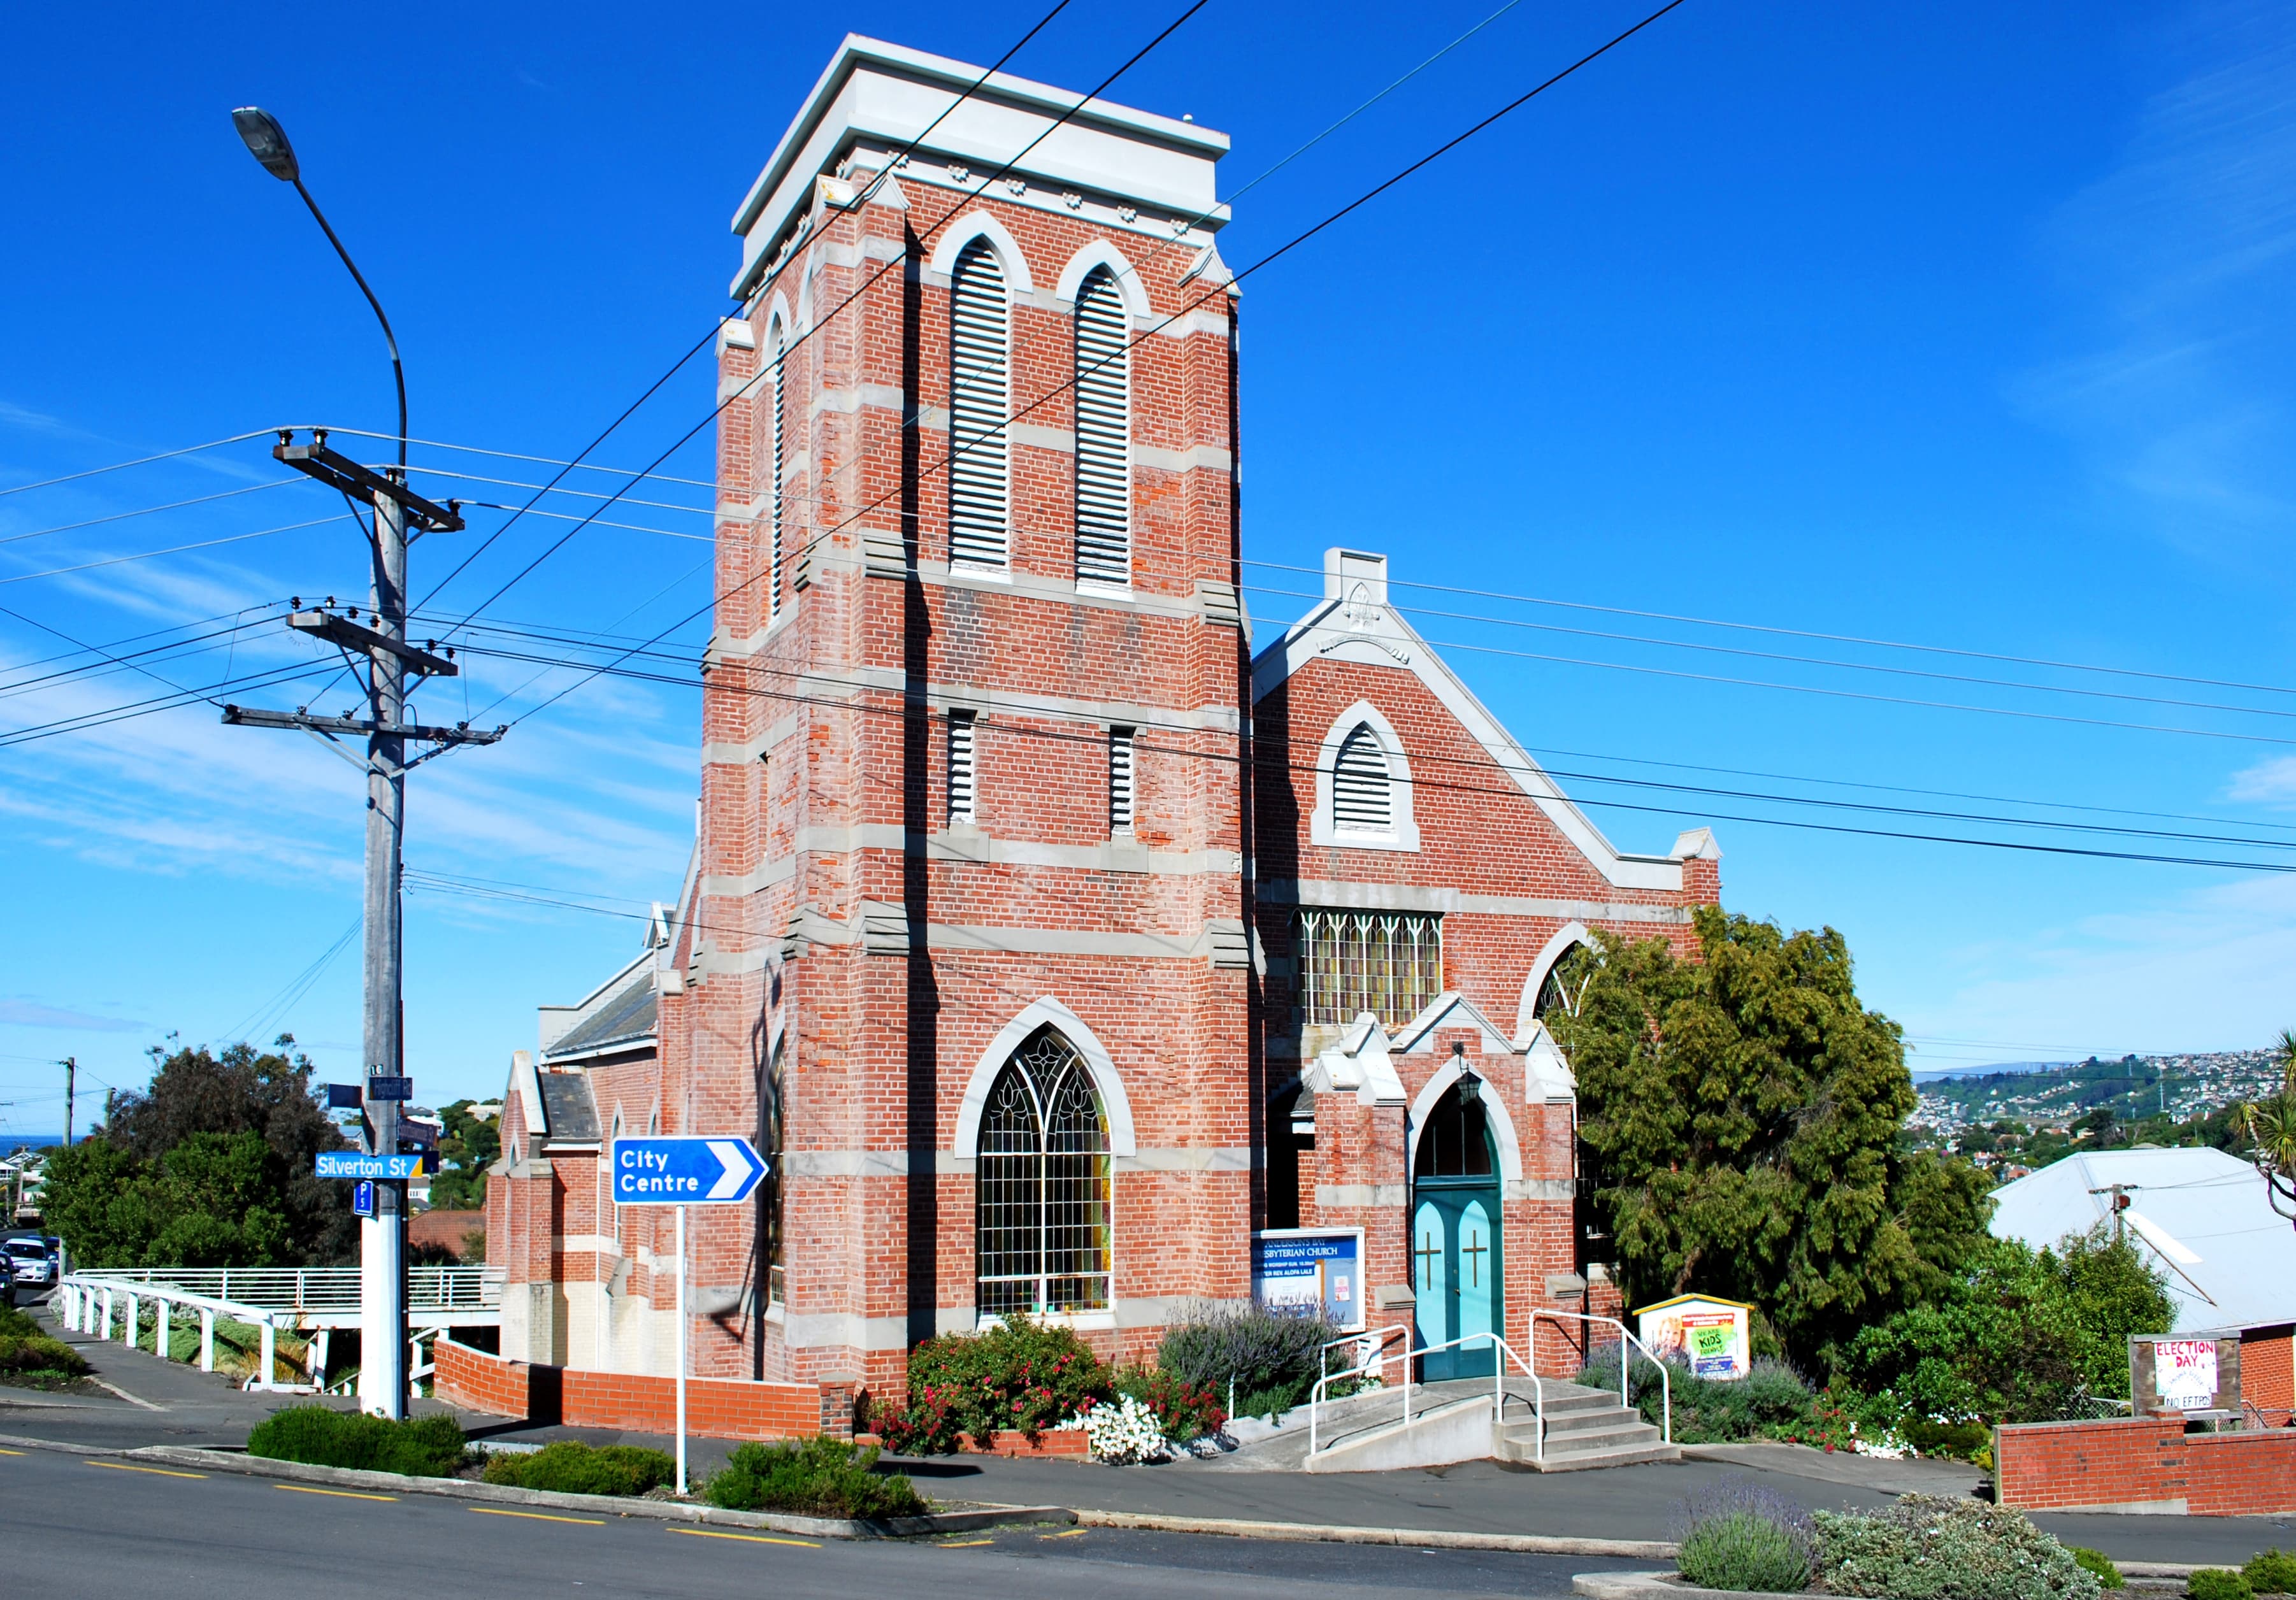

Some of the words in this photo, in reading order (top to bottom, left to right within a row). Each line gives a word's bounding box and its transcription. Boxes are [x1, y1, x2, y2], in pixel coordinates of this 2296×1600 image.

[371, 1064, 383, 1076] 16
[375, 1079, 401, 1099] Highcliff
[403, 1079, 412, 1096] Rd
[318, 1156, 384, 1175] Silverton
[389, 1157, 408, 1176] St
[621, 1150, 668, 1172] City
[360, 1182, 368, 1196] P
[621, 1174, 699, 1192] Centre
[360, 1197, 365, 1208] 5
[1312, 1238, 1326, 1246] BAY
[1307, 1246, 1338, 1257] CHURCH
[1699, 1333, 1721, 1348] KIDS
[2156, 1341, 2214, 1356] ELECTION
[2176, 1355, 2198, 1368] DAY
[2166, 1397, 2179, 1408] NO
[2183, 1396, 2211, 1407] EFTPOS
